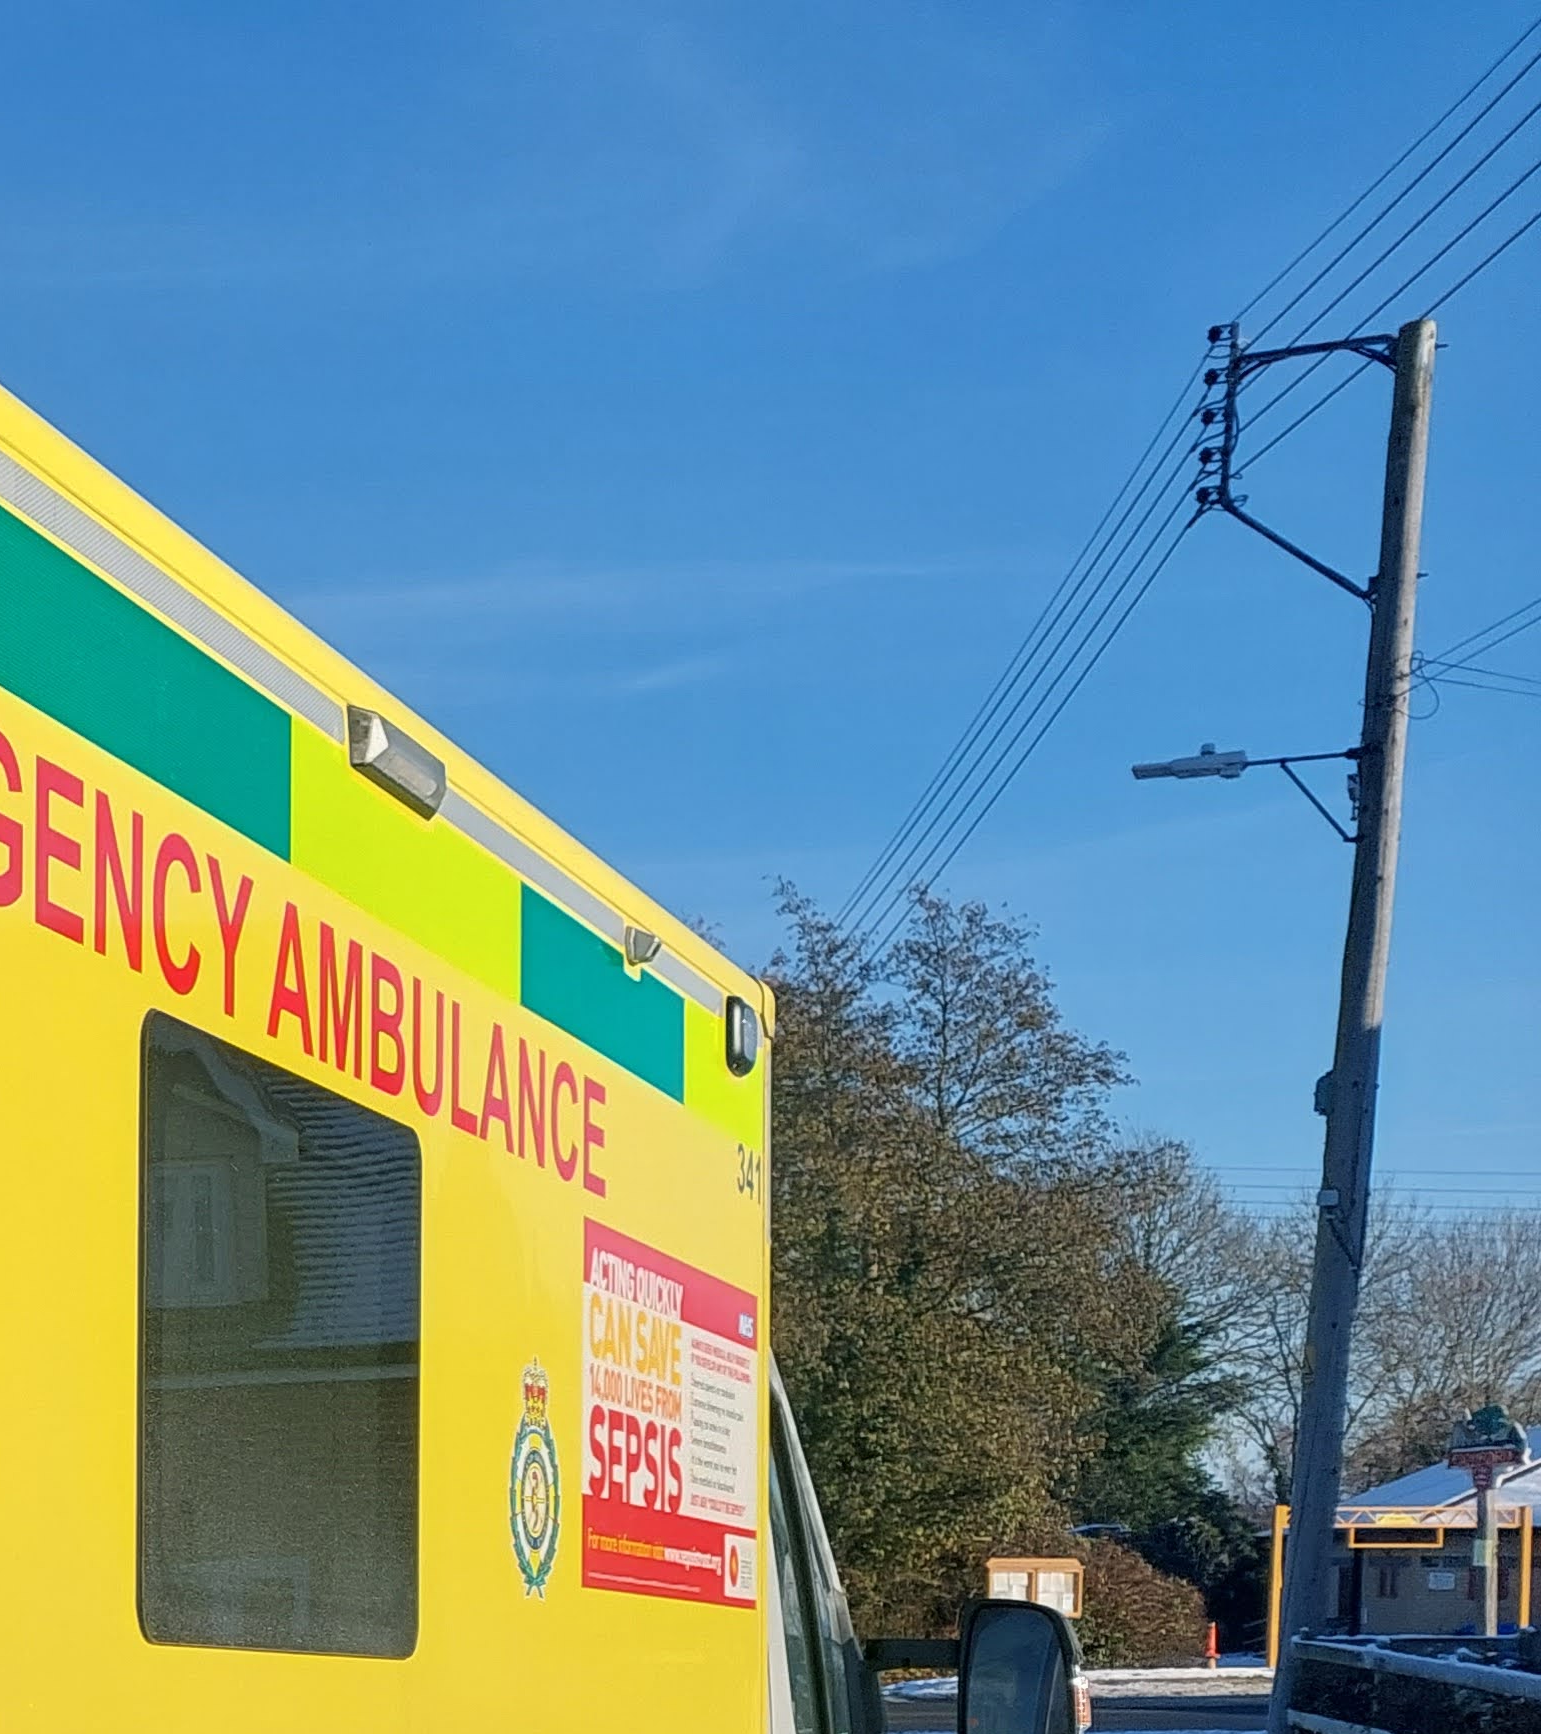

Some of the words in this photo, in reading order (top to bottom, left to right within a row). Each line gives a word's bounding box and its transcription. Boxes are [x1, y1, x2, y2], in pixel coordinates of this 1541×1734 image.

[266, 901, 608, 1198] AMBULANCE
[737, 1142, 761, 1205] 341
[590, 1246, 636, 1302] ACTING
[636, 1266, 684, 1321] QUICKLY
[590, 1292, 633, 1368] CAN
[635, 1310, 682, 1386] SAVE
[625, 1373, 654, 1414] LIVES
[655, 1384, 682, 1424] FROM
[589, 1403, 683, 1514] SEPSIS
